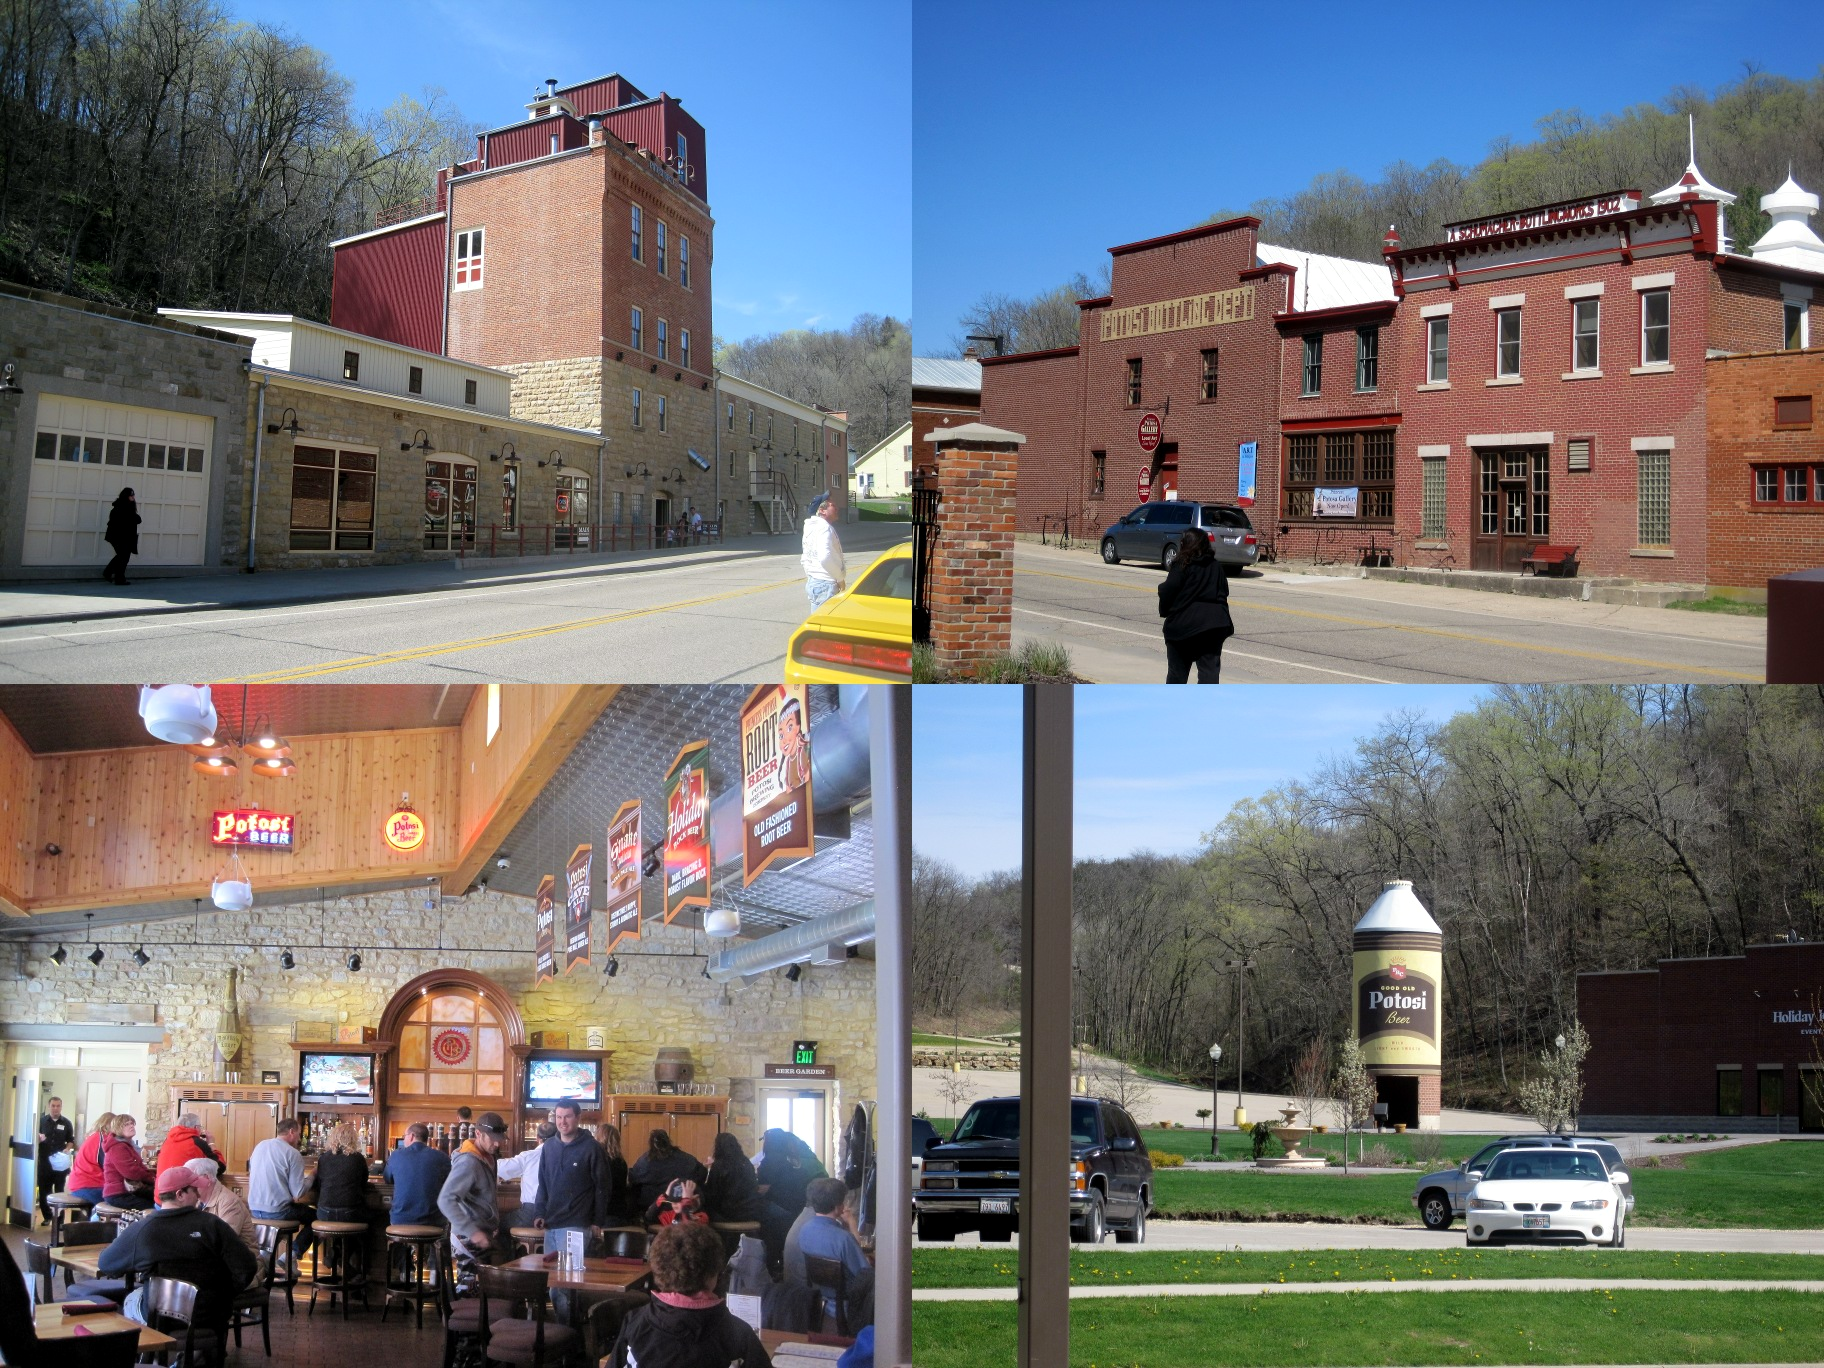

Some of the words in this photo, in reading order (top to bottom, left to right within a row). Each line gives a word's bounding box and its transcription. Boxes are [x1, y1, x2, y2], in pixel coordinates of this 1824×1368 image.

[1597, 196, 1621, 217] 1902
[1102, 307, 1149, 340] POTOSI
[1150, 296, 1215, 331] BOTTLING
[1242, 446, 1254, 455] ART
[746, 712, 777, 776] ROOT
[747, 758, 778, 789] BEER
[665, 789, 709, 852] Holiday
[753, 821, 765, 837] OLD
[765, 801, 797, 830] FASHIONED
[249, 830, 290, 844] BEER
[761, 829, 776, 848] ROOT
[776, 819, 792, 839] BEER
[1368, 990, 1427, 1010] Potosi
[1385, 1011, 1411, 1024] Beer
[1772, 1009, 1814, 1027] Holiday
[796, 1050, 814, 1064] EXIT
